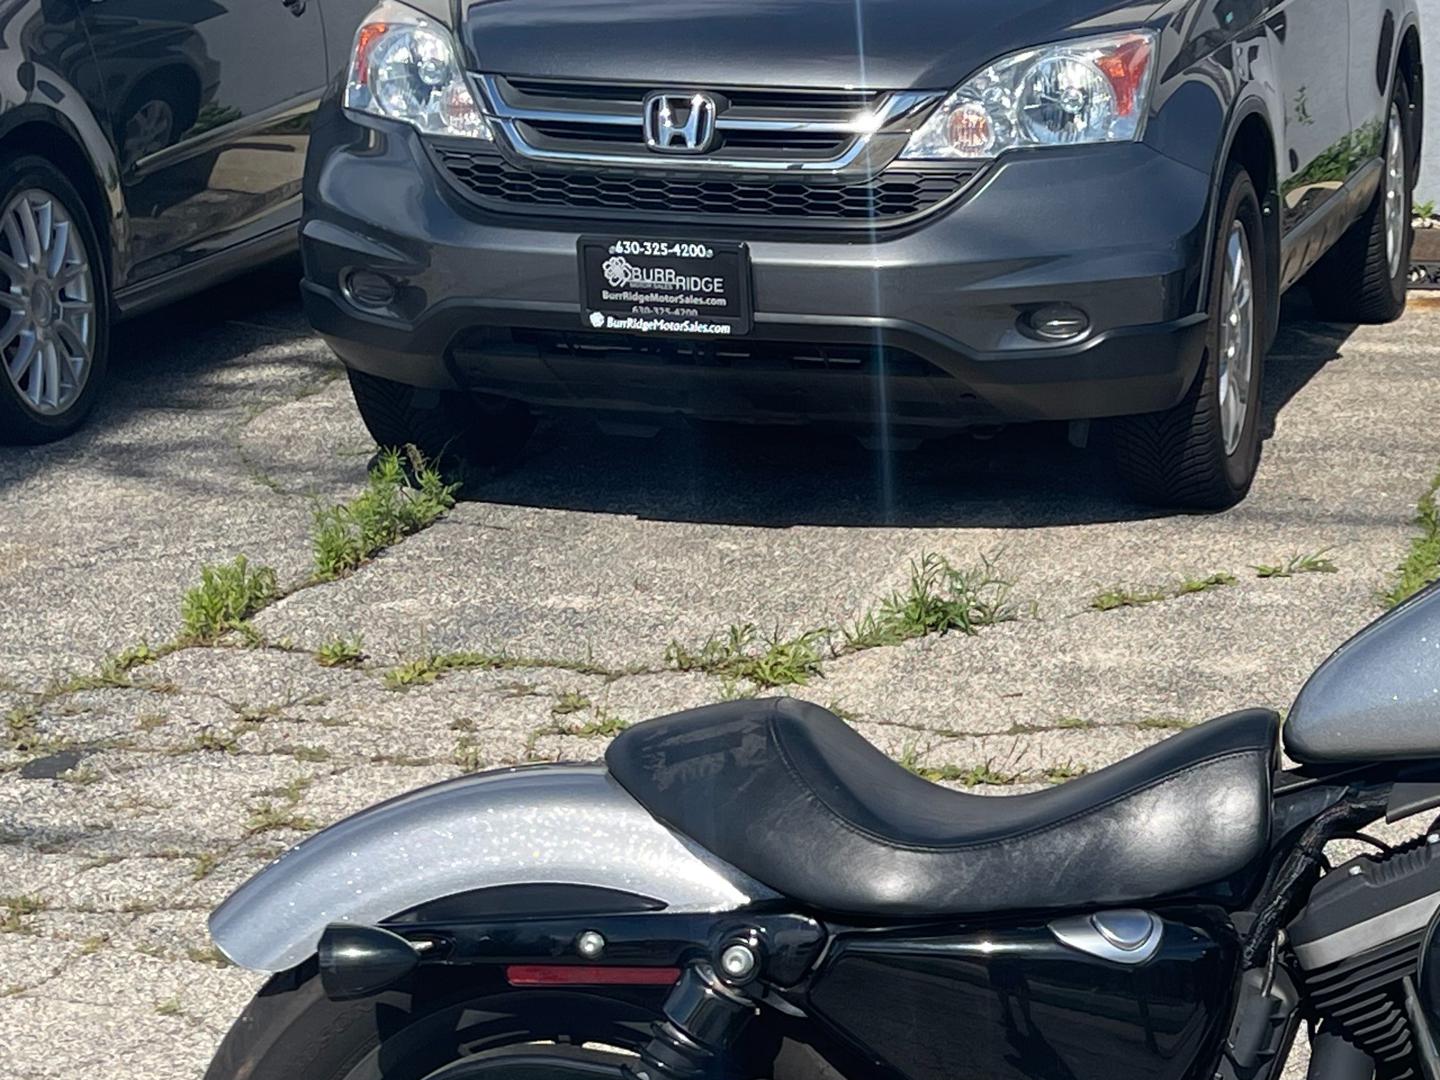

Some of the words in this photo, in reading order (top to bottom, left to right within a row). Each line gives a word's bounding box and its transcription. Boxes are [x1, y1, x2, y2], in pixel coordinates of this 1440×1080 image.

[615, 240, 706, 258] 630-325-4200
[631, 267, 676, 283] BURR
[676, 276, 724, 293] RIDGE
[602, 290, 727, 306] BurrRidgeMotorSales.com
[606, 316, 730, 334] BurrRidgeMotorSales.com
